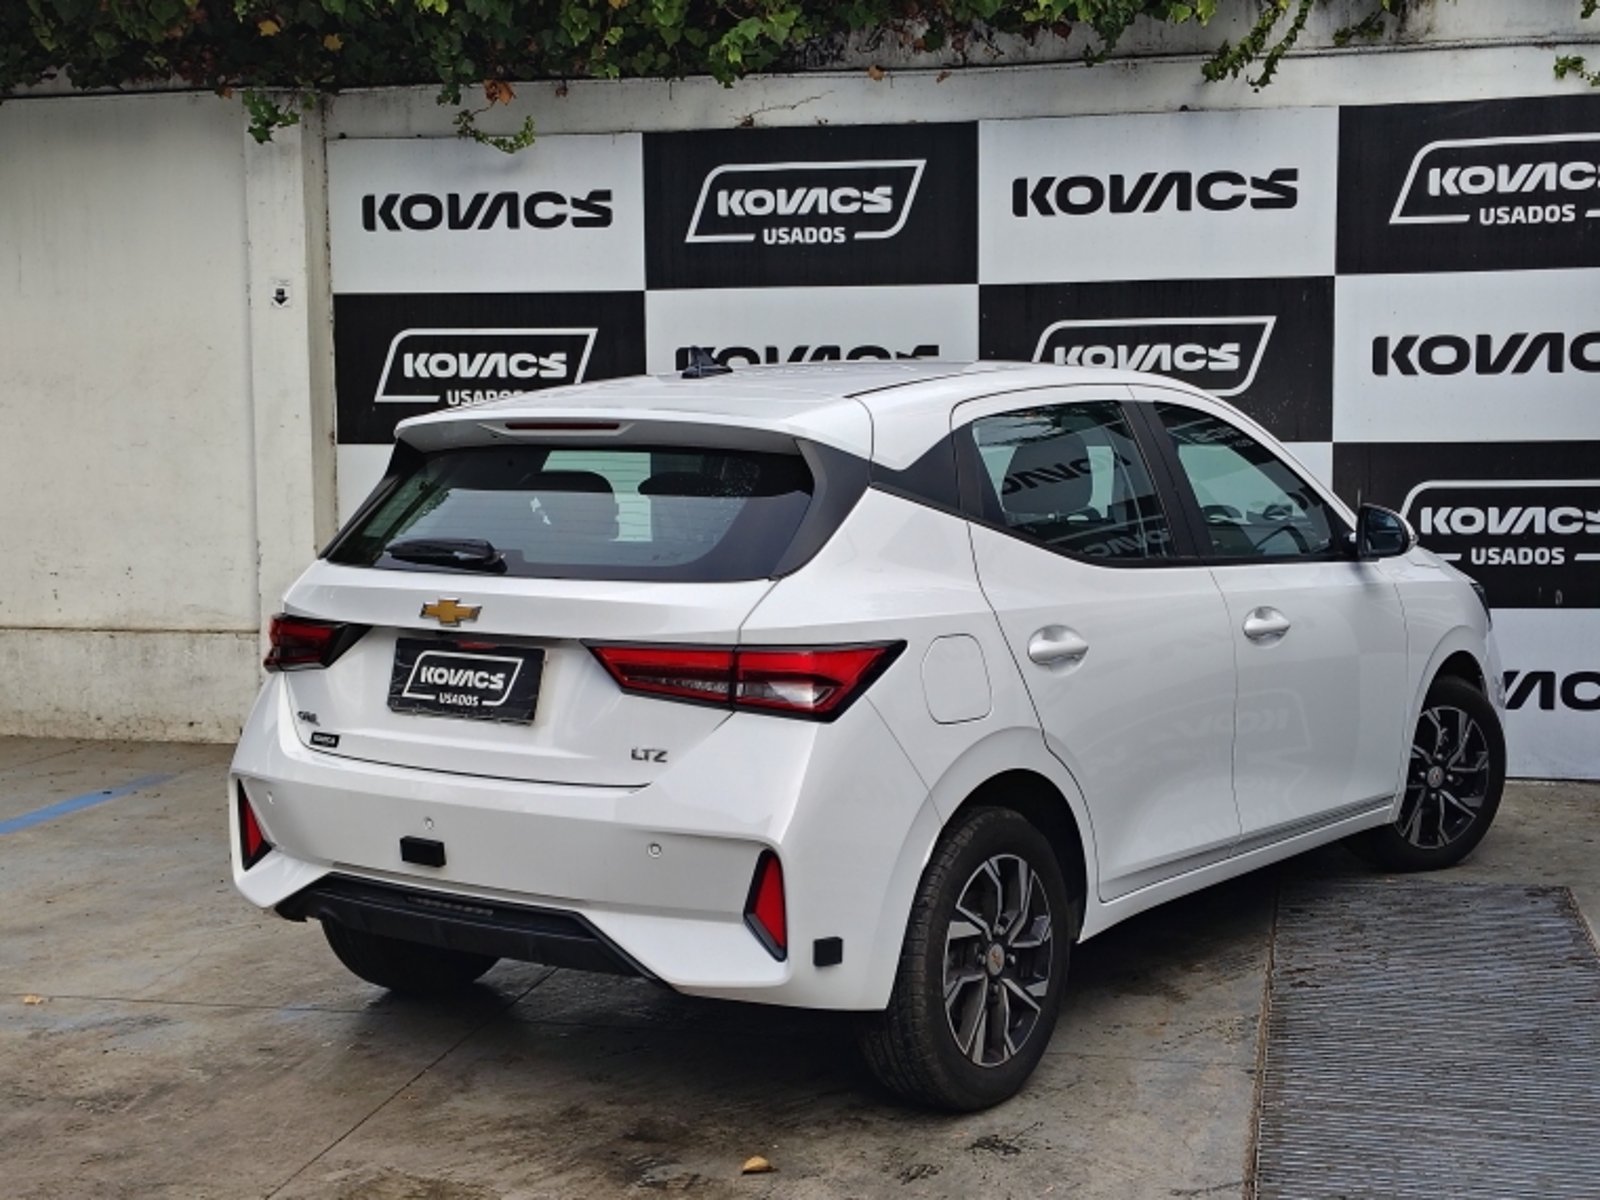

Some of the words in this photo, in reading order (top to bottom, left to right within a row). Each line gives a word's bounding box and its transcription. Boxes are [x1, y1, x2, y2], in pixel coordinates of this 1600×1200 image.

[1427, 161, 1600, 197] KOVAC
[717, 186, 893, 217] KOVACS
[1012, 168, 1299, 218] KOVACS
[362, 189, 613, 232] KOVACS
[1478, 204, 1576, 226] USADOS
[762, 226, 847, 246] USADOS
[403, 352, 568, 379] KOVACS
[1053, 342, 1240, 372] KOVACS
[1470, 547, 1566, 566] USADOS
[420, 666, 506, 690] KOVACS
[438, 692, 479, 707] USADOS
[630, 747, 669, 763] LTZ
